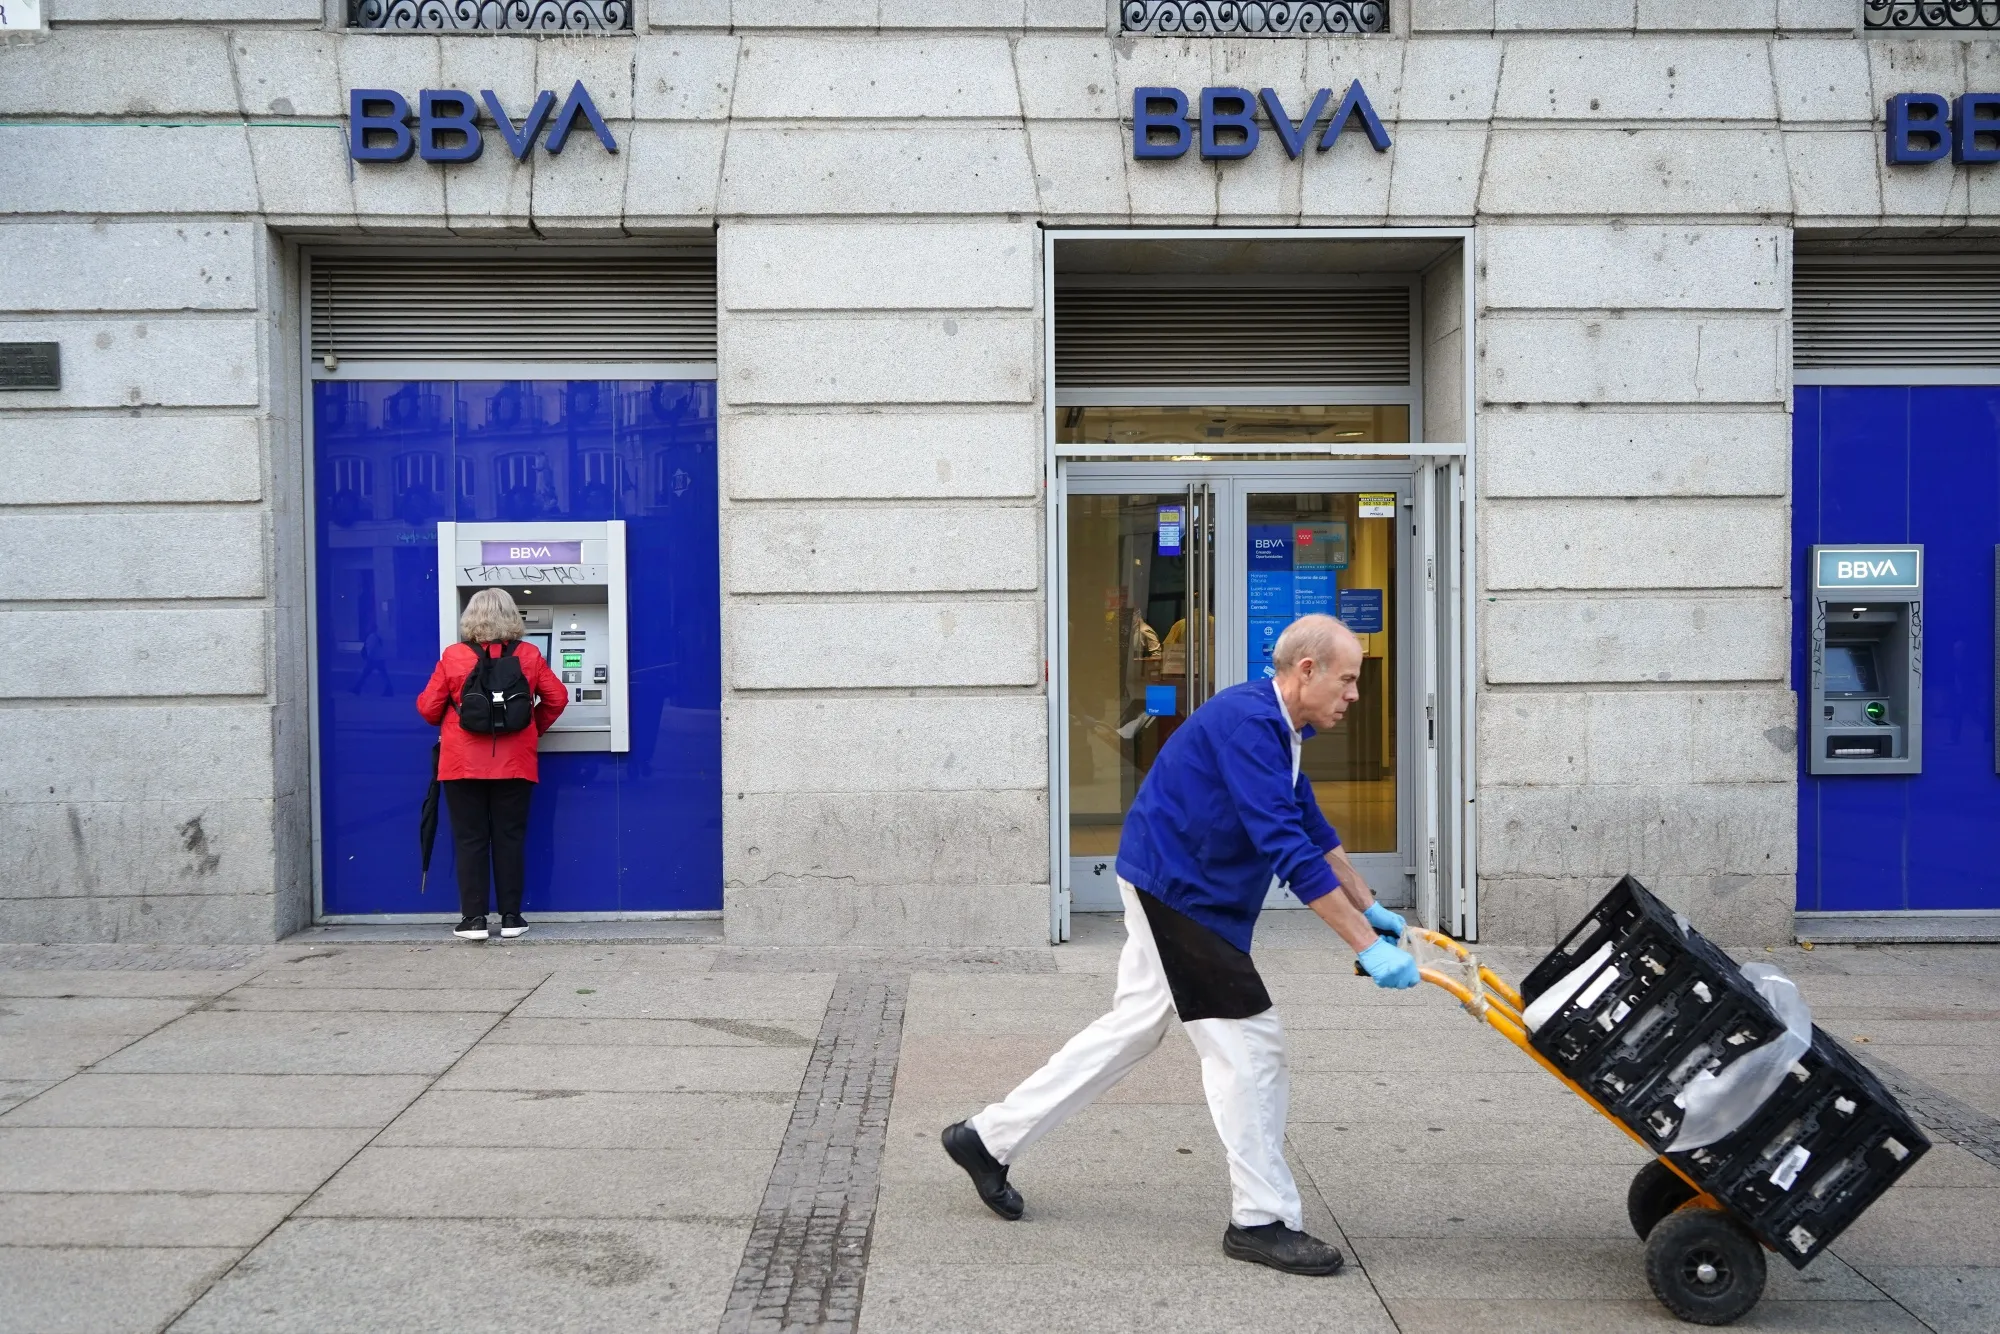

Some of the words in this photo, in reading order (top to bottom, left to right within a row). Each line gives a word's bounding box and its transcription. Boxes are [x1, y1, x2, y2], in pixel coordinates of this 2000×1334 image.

[350, 79, 620, 163] BBVA
[1133, 78, 1392, 160] BBVA
[510, 546, 551, 559] BBVA
[1255, 539, 1284, 549] BBVA
[1838, 559, 1898, 579] BBVA
